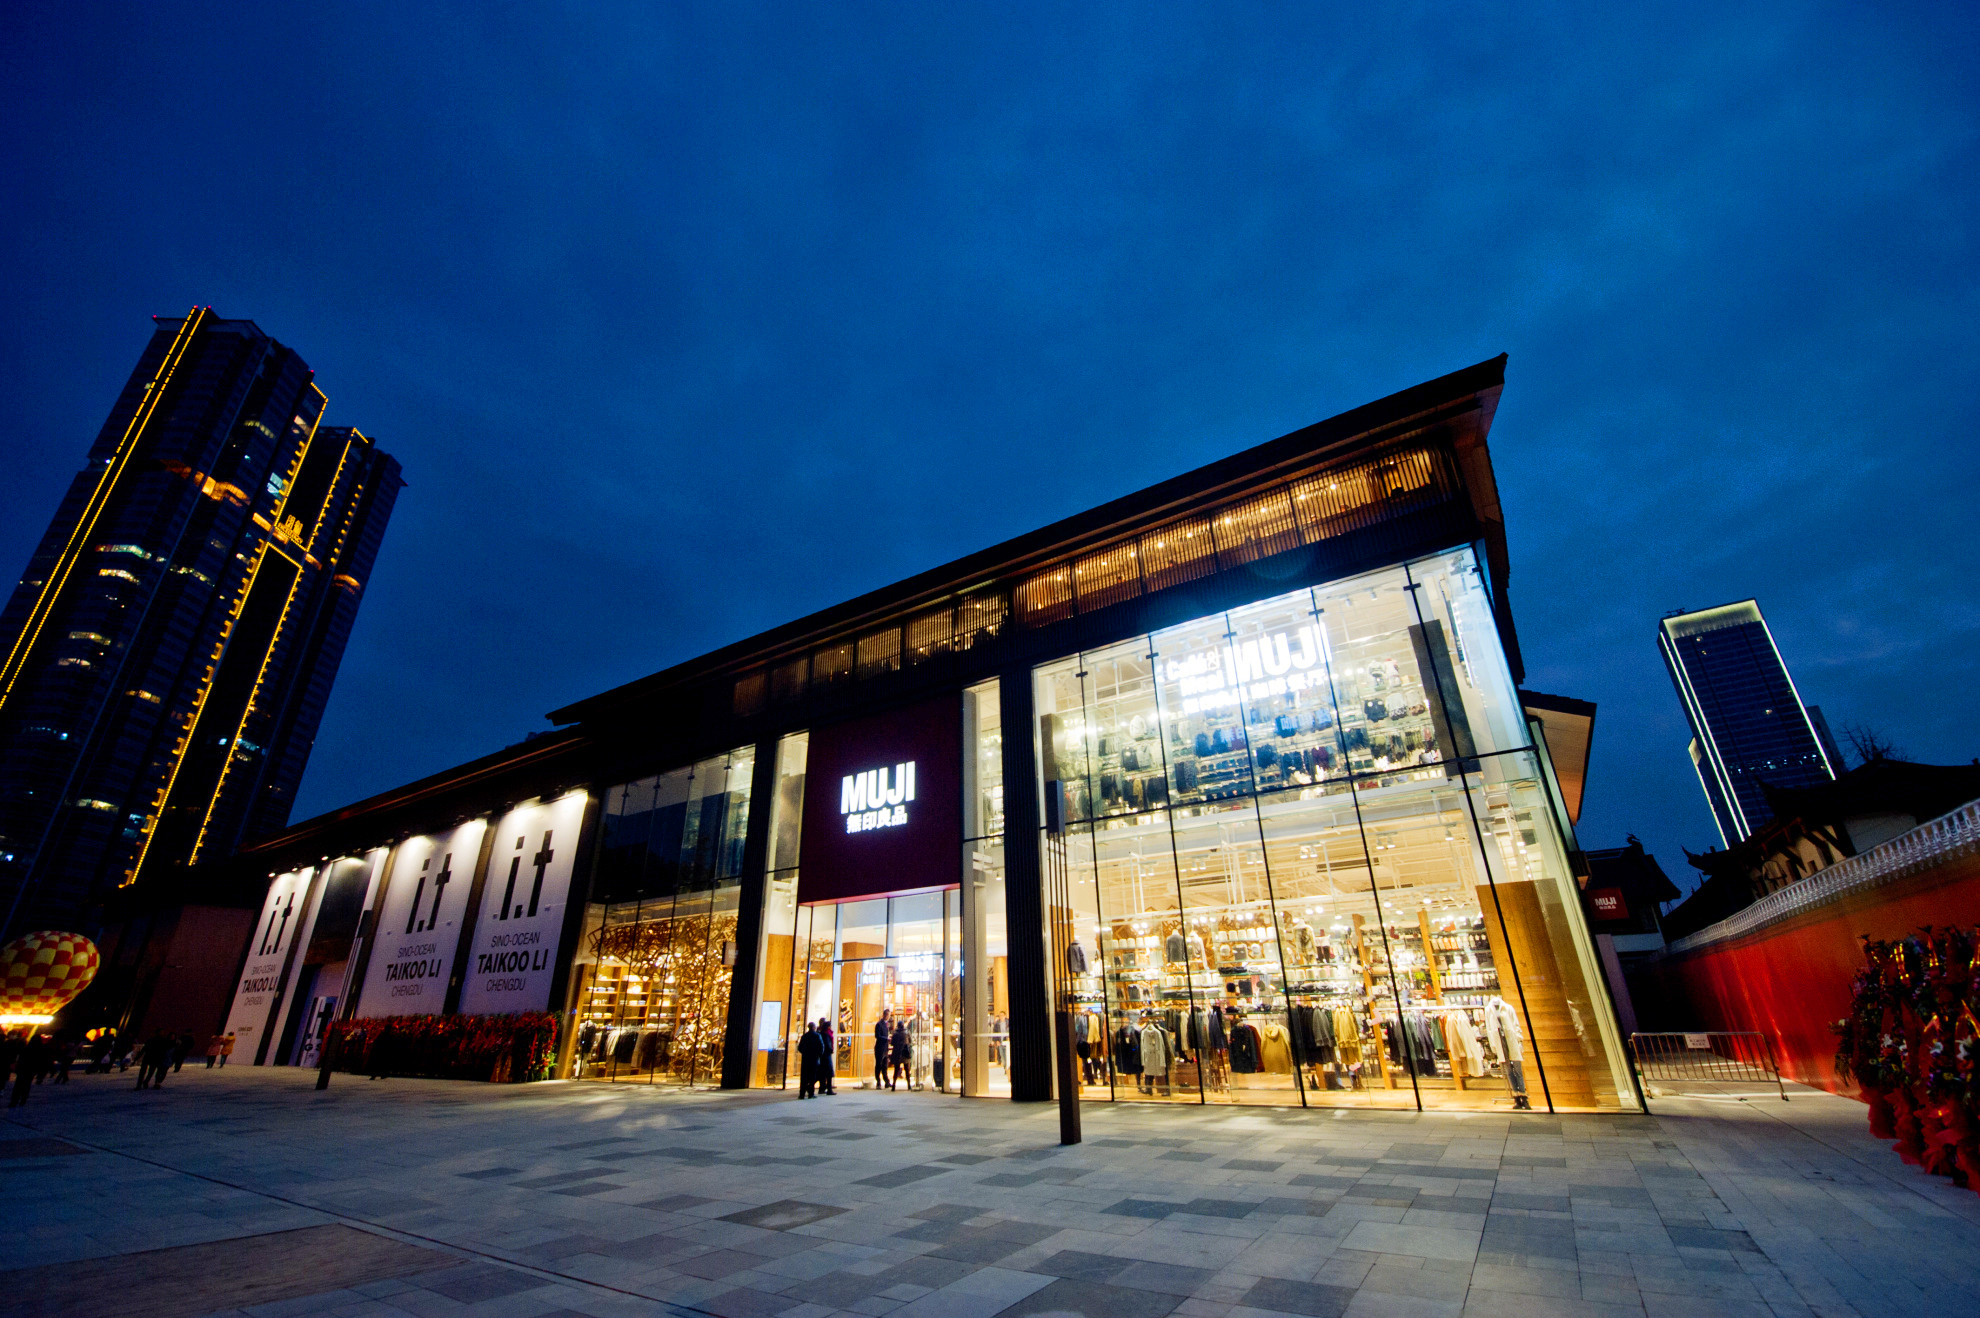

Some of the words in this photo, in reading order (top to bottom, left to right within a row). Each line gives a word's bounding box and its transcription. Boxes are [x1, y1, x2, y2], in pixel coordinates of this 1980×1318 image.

[1223, 622, 1333, 686] MUJI
[840, 761, 916, 815] MUJI
[846, 805, 908, 834] 無印良品
[499, 829, 555, 921] i.t
[405, 852, 453, 934] i.t
[1594, 896, 1617, 906] MUJI
[258, 891, 296, 956] i.t
[398, 943, 437, 959] SINO-OCEAN
[491, 931, 541, 948] SINO-OCEAN
[386, 960, 427, 981] TAIKOO
[428, 959, 442, 978] LI
[477, 951, 530, 974] TAIKOO
[532, 949, 549, 971] LI
[242, 976, 269, 994] TAIKOO
[267, 975, 279, 991] LI
[391, 983, 424, 998] CHENGDU
[486, 978, 526, 992] CHENGDU
